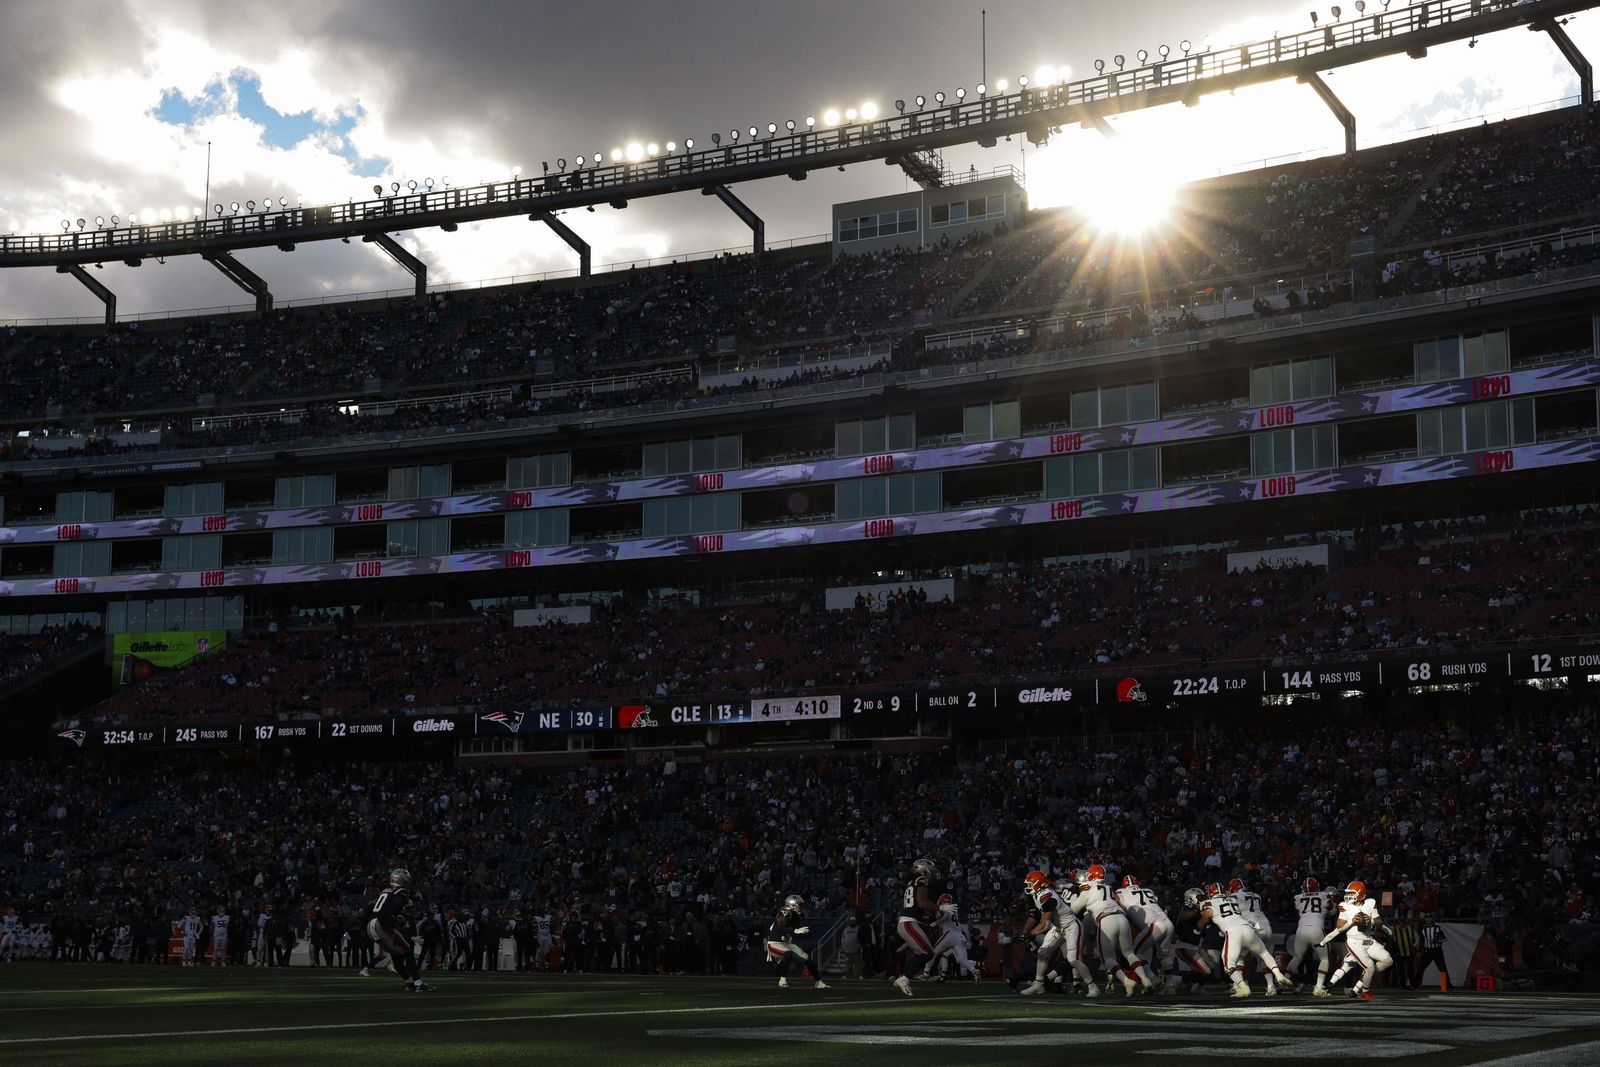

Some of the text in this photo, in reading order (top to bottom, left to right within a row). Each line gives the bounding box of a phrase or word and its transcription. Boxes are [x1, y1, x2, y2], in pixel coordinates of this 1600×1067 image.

[1259, 406, 1293, 428] LOUD
[1050, 433, 1081, 454] LOUD
[864, 456, 893, 474] LOUD
[695, 474, 723, 491] LOUD
[1261, 477, 1295, 498] LOUD
[357, 505, 383, 520] LOUD
[1051, 501, 1082, 521] LOUD
[202, 515, 226, 531] LOUD
[864, 520, 893, 538] LOUD
[57, 525, 81, 540] LOUD
[695, 535, 723, 552] LOUD
[356, 561, 381, 577] LOUD
[55, 579, 79, 593] LOUD
[200, 571, 225, 586] LOUD
[1407, 662, 1487, 681] 68 RUSH YDS
[1531, 653, 1552, 673] 12
[1559, 655, 1577, 668] 1ST
[1173, 676, 1247, 696] 22:24 T.O.P
[1282, 670, 1361, 689] 144 PASS YDS
[876, 699, 884, 710] &
[890, 695, 901, 712] 9
[929, 691, 977, 708] BALL ON 2
[1018, 687, 1072, 704] Gillette
[671, 704, 732, 723] CLE 13
[794, 700, 828, 715] 4:10
[412, 718, 455, 733] Gillette
[539, 711, 593, 729] NE 30
[103, 730, 154, 744] 32:54 T.O.P
[175, 728, 228, 742] 245 PASS YDS
[254, 725, 307, 740] 167 RUSH YDS
[331, 722, 383, 737] 22 1ST DOWNS
[373, 893, 388, 912] 0
[1300, 897, 1322, 913] 78
[1479, 977, 1490, 990] G
